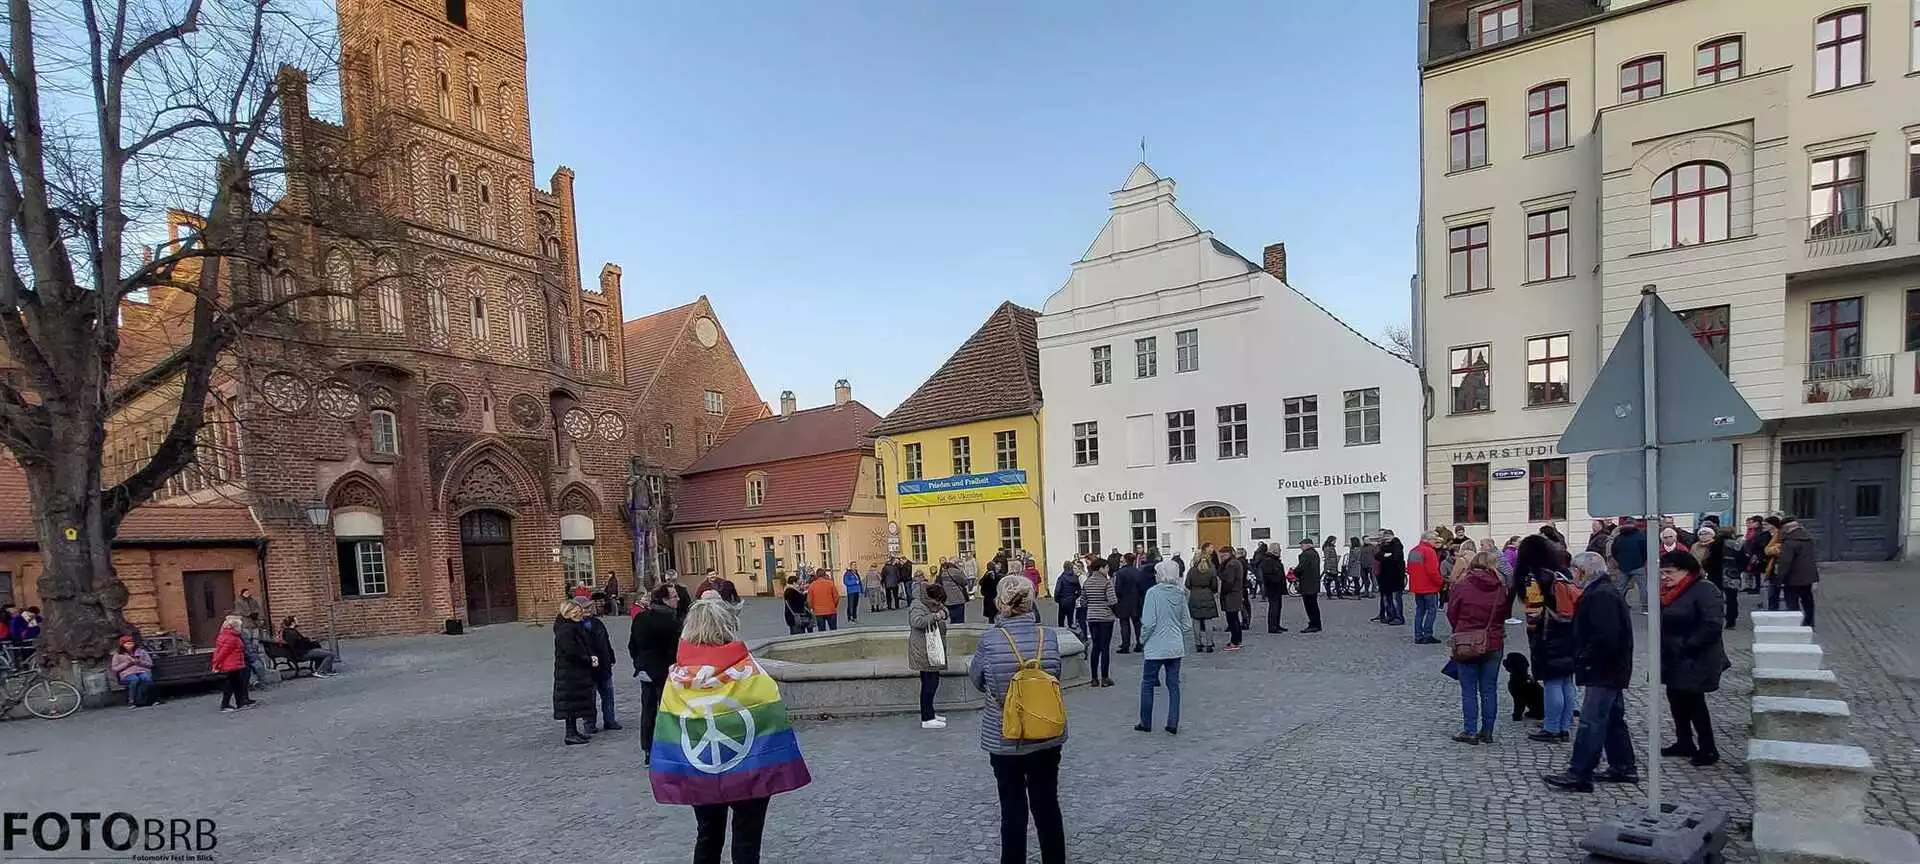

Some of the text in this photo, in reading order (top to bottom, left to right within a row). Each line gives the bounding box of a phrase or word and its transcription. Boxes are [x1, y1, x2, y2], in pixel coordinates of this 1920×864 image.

[1453, 445, 1559, 461] HAARSTUDI
[952, 479, 964, 487] und
[1278, 472, 1387, 490] Fouqué-Bibliothek
[1083, 490, 1145, 504] Café Undine
